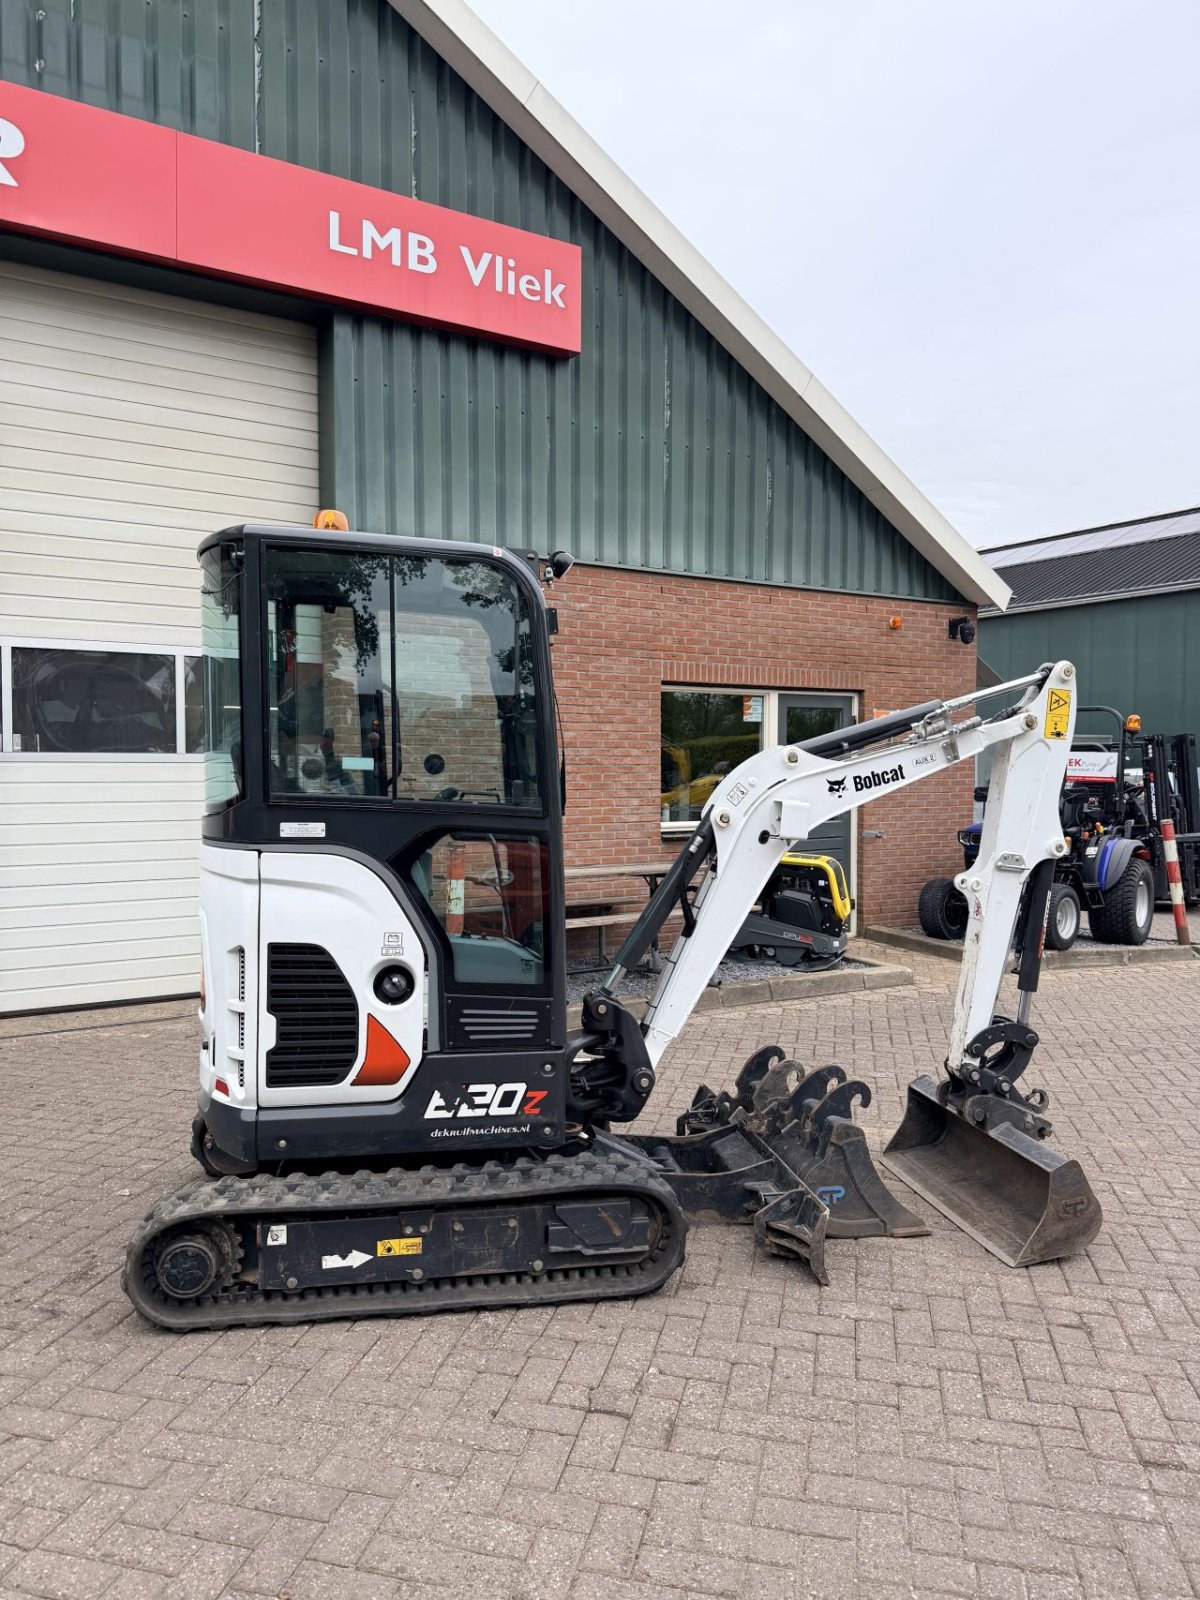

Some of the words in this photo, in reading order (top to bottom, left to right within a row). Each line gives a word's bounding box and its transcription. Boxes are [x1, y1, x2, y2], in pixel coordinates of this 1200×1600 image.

[329, 210, 438, 274] LMB
[459, 245, 567, 309] Vliek
[915, 756, 929, 766] AUX
[853, 764, 906, 792] Bobcat
